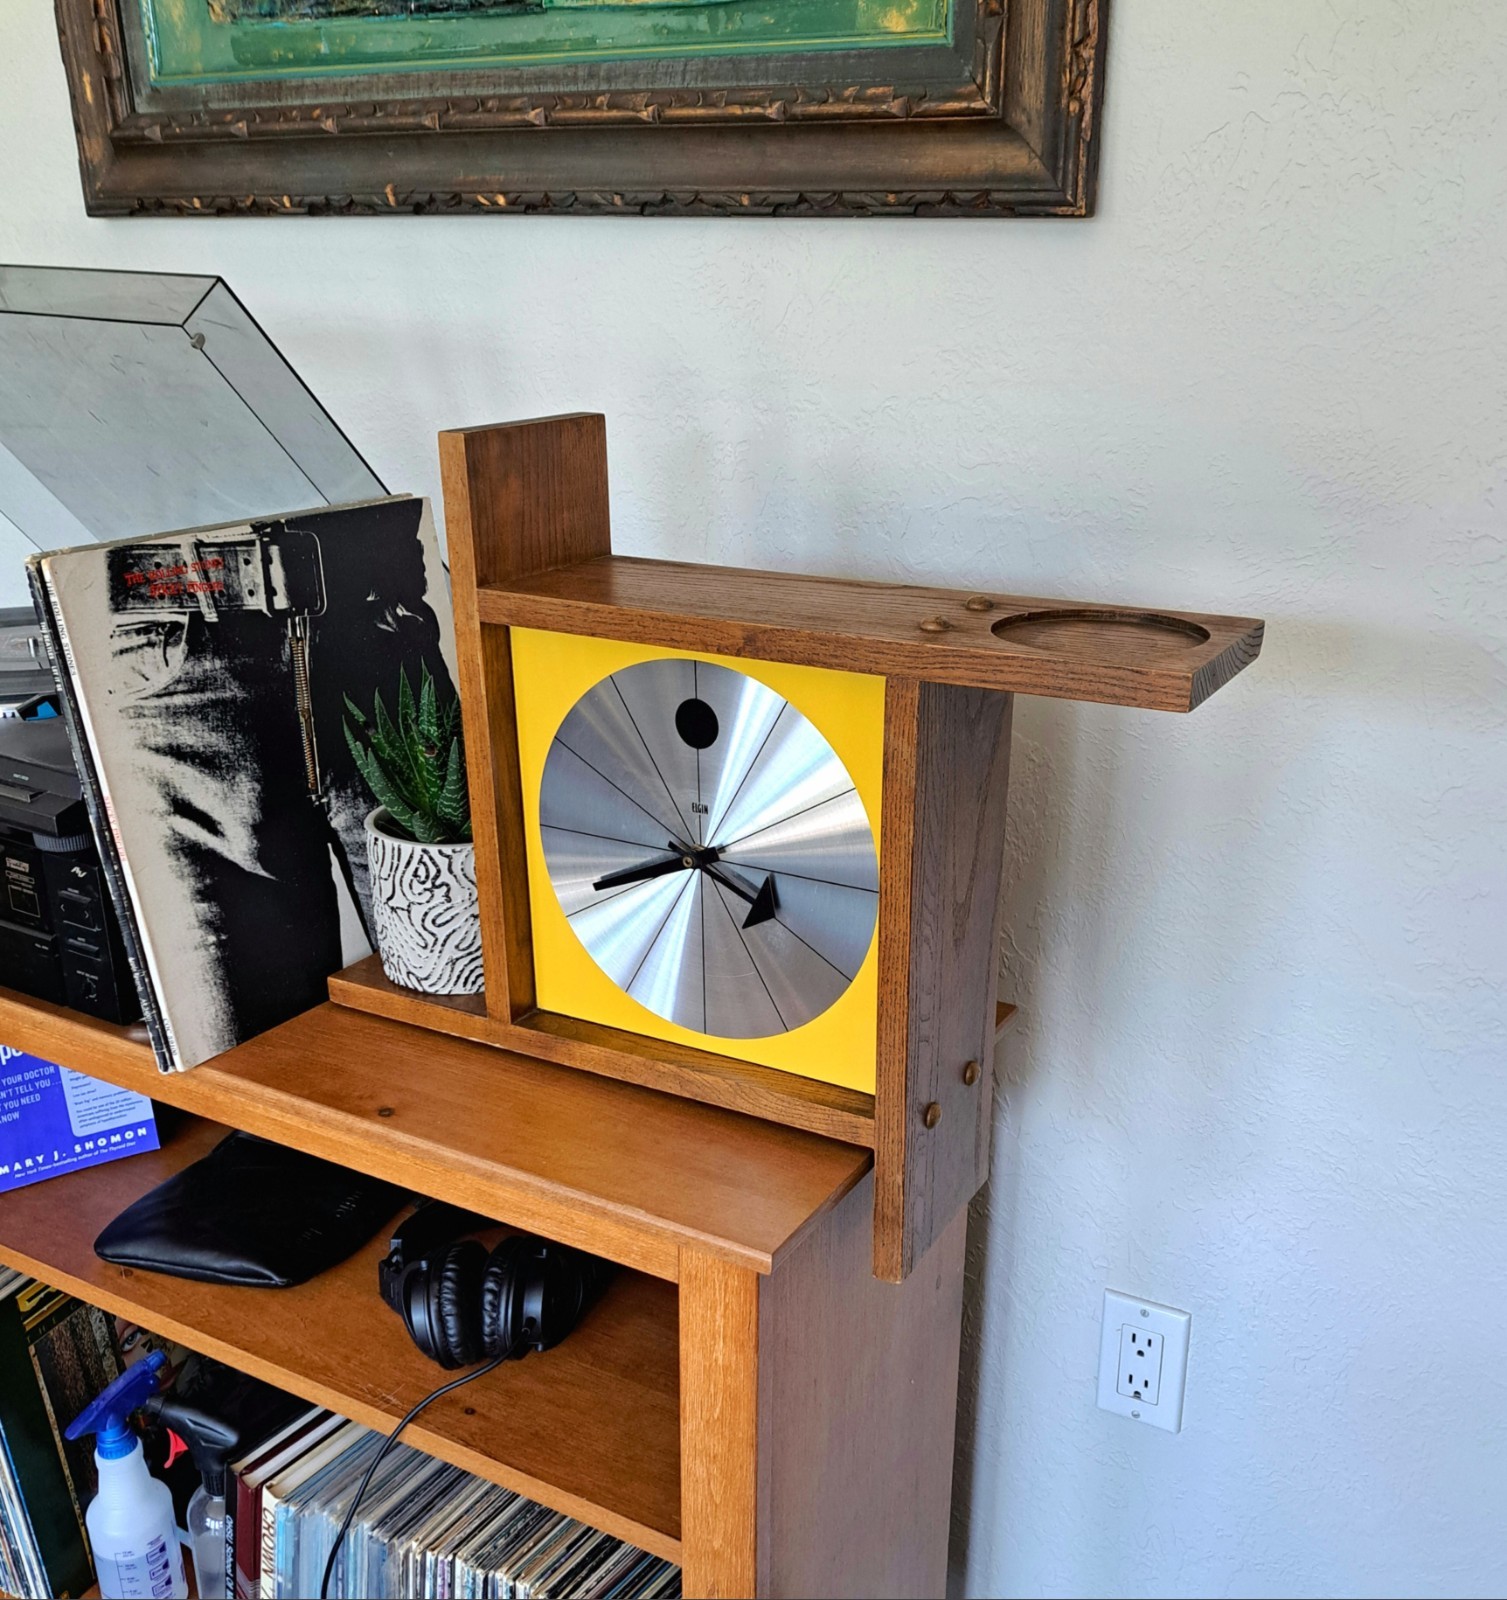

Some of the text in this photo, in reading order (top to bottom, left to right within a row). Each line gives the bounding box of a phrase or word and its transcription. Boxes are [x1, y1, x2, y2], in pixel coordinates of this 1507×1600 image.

[124, 572, 146, 588] THE
[146, 564, 188, 581] ROLLING
[43, 634, 54, 660] BEATLES
[51, 600, 68, 640] ROLLING
[62, 641, 77, 676] STONES
[691, 802, 709, 815] ELGIN
[1, 1074, 23, 1087] YOUR
[23, 1066, 55, 1081] DOCTOR
[0, 1088, 14, 1100] N'T
[14, 1083, 34, 1096] TELL
[3, 1093, 41, 1111] YOU NEED
[0, 1111, 20, 1124] NOW
[0, 1127, 147, 1176] MARY J. SHOMON
[262, 1506, 275, 1580] CROWN
